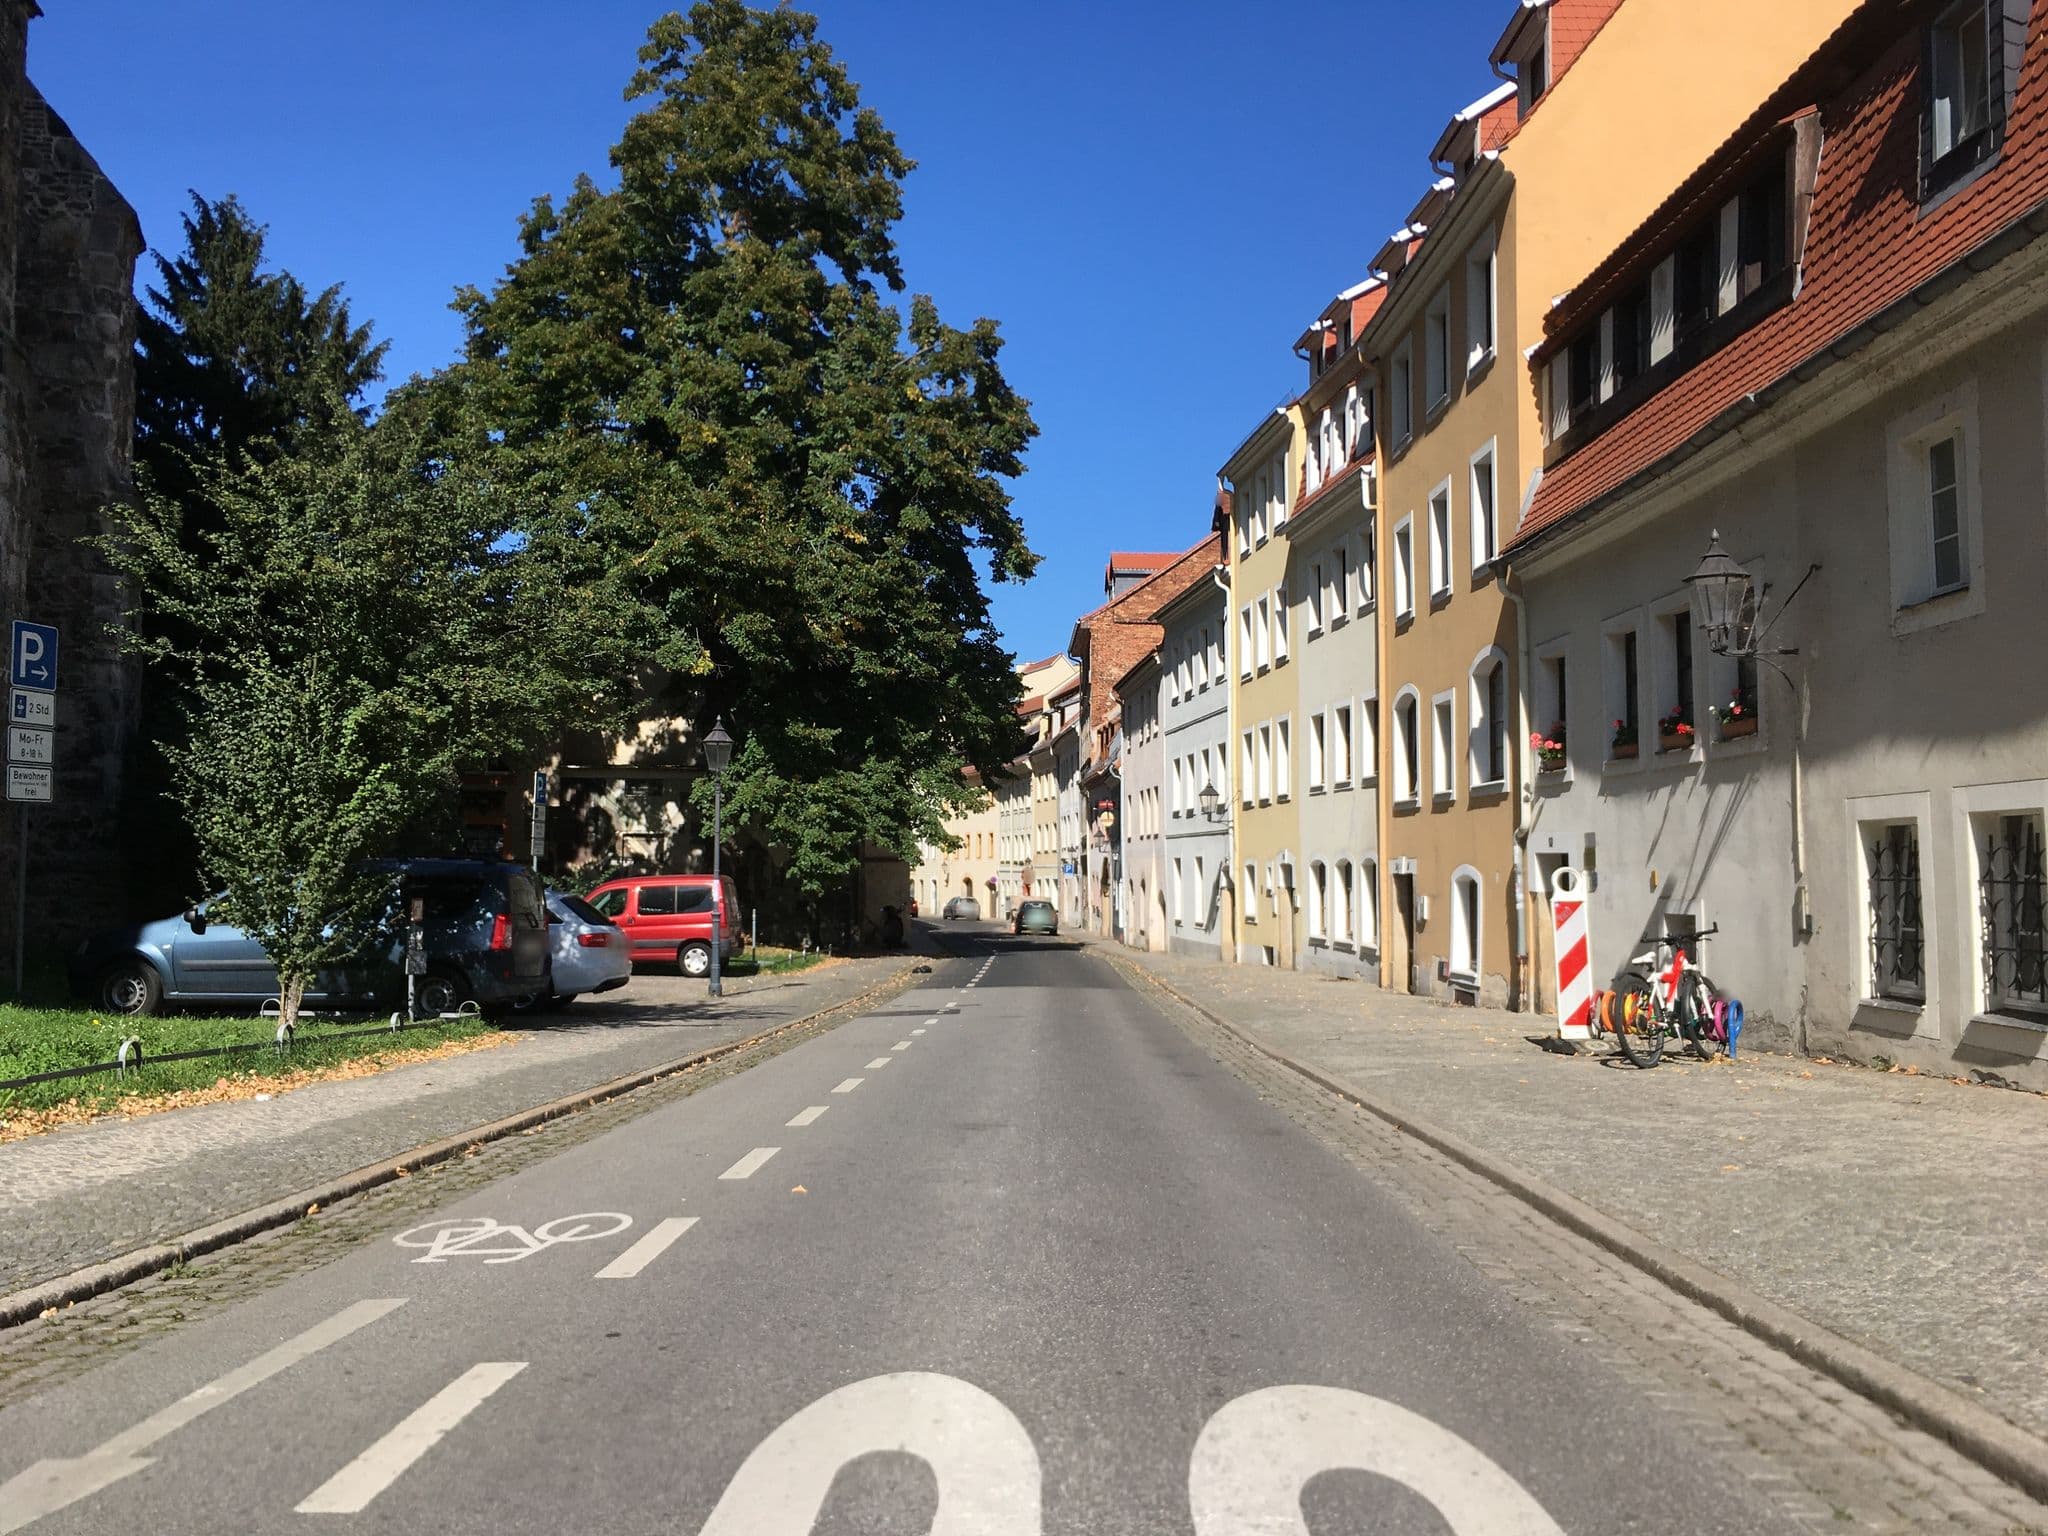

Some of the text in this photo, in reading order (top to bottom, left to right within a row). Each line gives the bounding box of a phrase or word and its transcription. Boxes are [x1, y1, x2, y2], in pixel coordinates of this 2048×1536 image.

[20, 630, 44, 678] P
[29, 702, 34, 713] 2
[19, 732, 43, 745] Mo-Fr
[13, 769, 47, 781] Bewohner
[24, 786, 37, 796] frei
[1065, 864, 1072, 873] P
